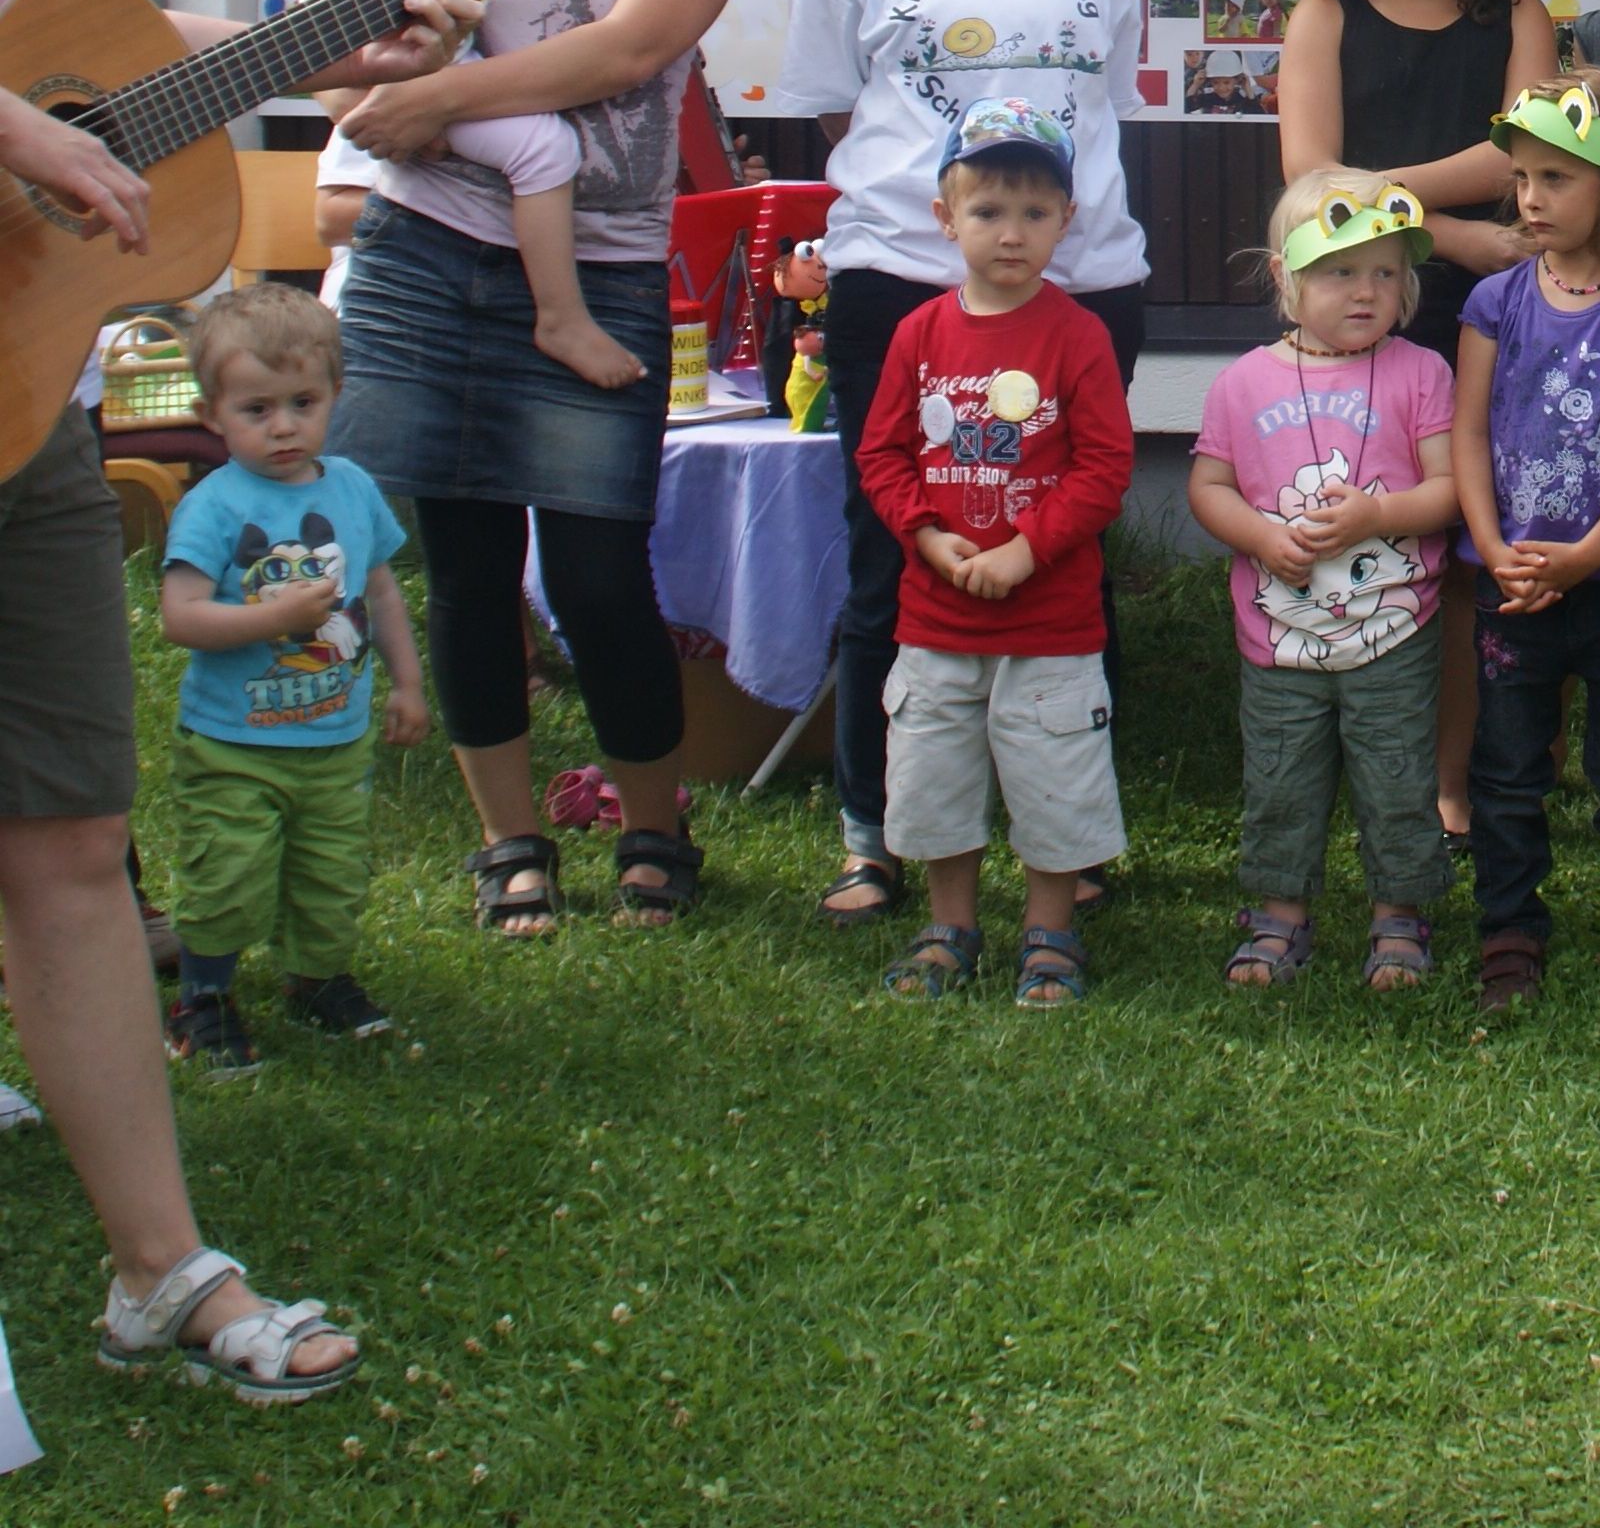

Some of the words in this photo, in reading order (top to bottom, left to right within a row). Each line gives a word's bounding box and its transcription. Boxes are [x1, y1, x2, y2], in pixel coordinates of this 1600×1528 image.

[1257, 389, 1377, 434] marie
[952, 421, 1025, 464] 02
[244, 664, 343, 711] THE
[245, 693, 348, 729] COOLEST
